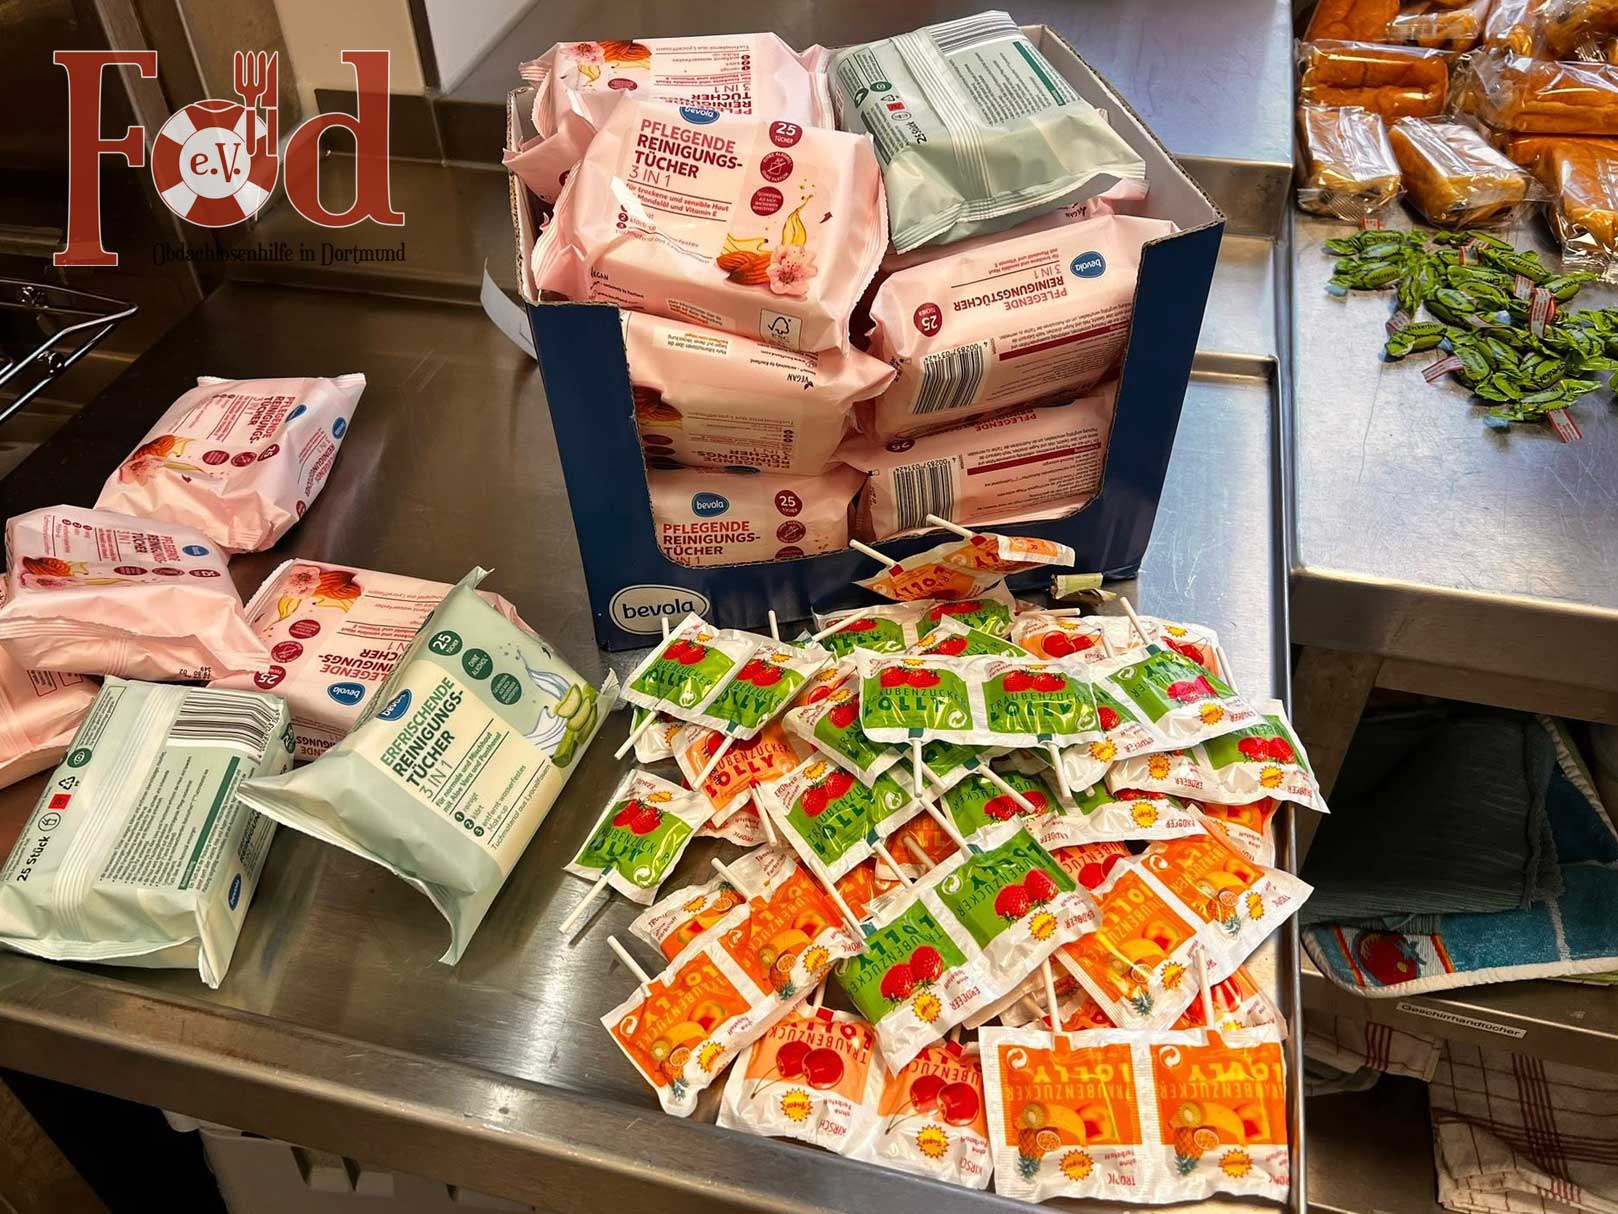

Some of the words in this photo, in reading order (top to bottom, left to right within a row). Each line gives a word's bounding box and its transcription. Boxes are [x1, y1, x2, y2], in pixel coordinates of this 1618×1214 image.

[640, 119, 737, 154] PFLEGENDE
[775, 123, 796, 136] 25
[637, 135, 743, 169] REINIGUNGS-
[629, 164, 639, 179] 3
[643, 167, 661, 186] IN
[664, 174, 671, 188] 1
[634, 150, 699, 179] TÜCHER
[1074, 258, 1101, 273] bevola
[953, 276, 1064, 312] REINIGUNGSTÜCHER
[1004, 287, 1068, 311] PFLEGENDE
[923, 313, 938, 331] 25
[975, 412, 1037, 431] PFLEGENDE
[696, 499, 724, 510] bevola
[779, 495, 796, 508] 25
[663, 521, 750, 535] PFLEGENDE
[663, 532, 760, 546] REINIGUNGS-
[664, 545, 723, 557] TÜCHER
[622, 598, 695, 619] bevola
[433, 633, 452, 650] 25
[318, 654, 396, 673] INIGUNGS-
[320, 664, 388, 682] LEGENDE
[332, 684, 361, 698] bevola
[380, 676, 455, 768] ERFRISCHENDE
[392, 689, 464, 778] REINIGUNGS-
[406, 730, 456, 788] TÜCHER
[419, 785, 434, 799] 3
[427, 768, 446, 788] IN
[450, 786, 464, 801] Aloe
[460, 772, 474, 788] Vera
[813, 790, 875, 855] LOLLY
[16, 865, 32, 884] 25
[25, 832, 51, 866] Stück
[858, 915, 936, 972] LOLLY
[1401, 1003, 1521, 1037] Geschirrhandtücher
[768, 1025, 867, 1065] TRAUBENZUCK
